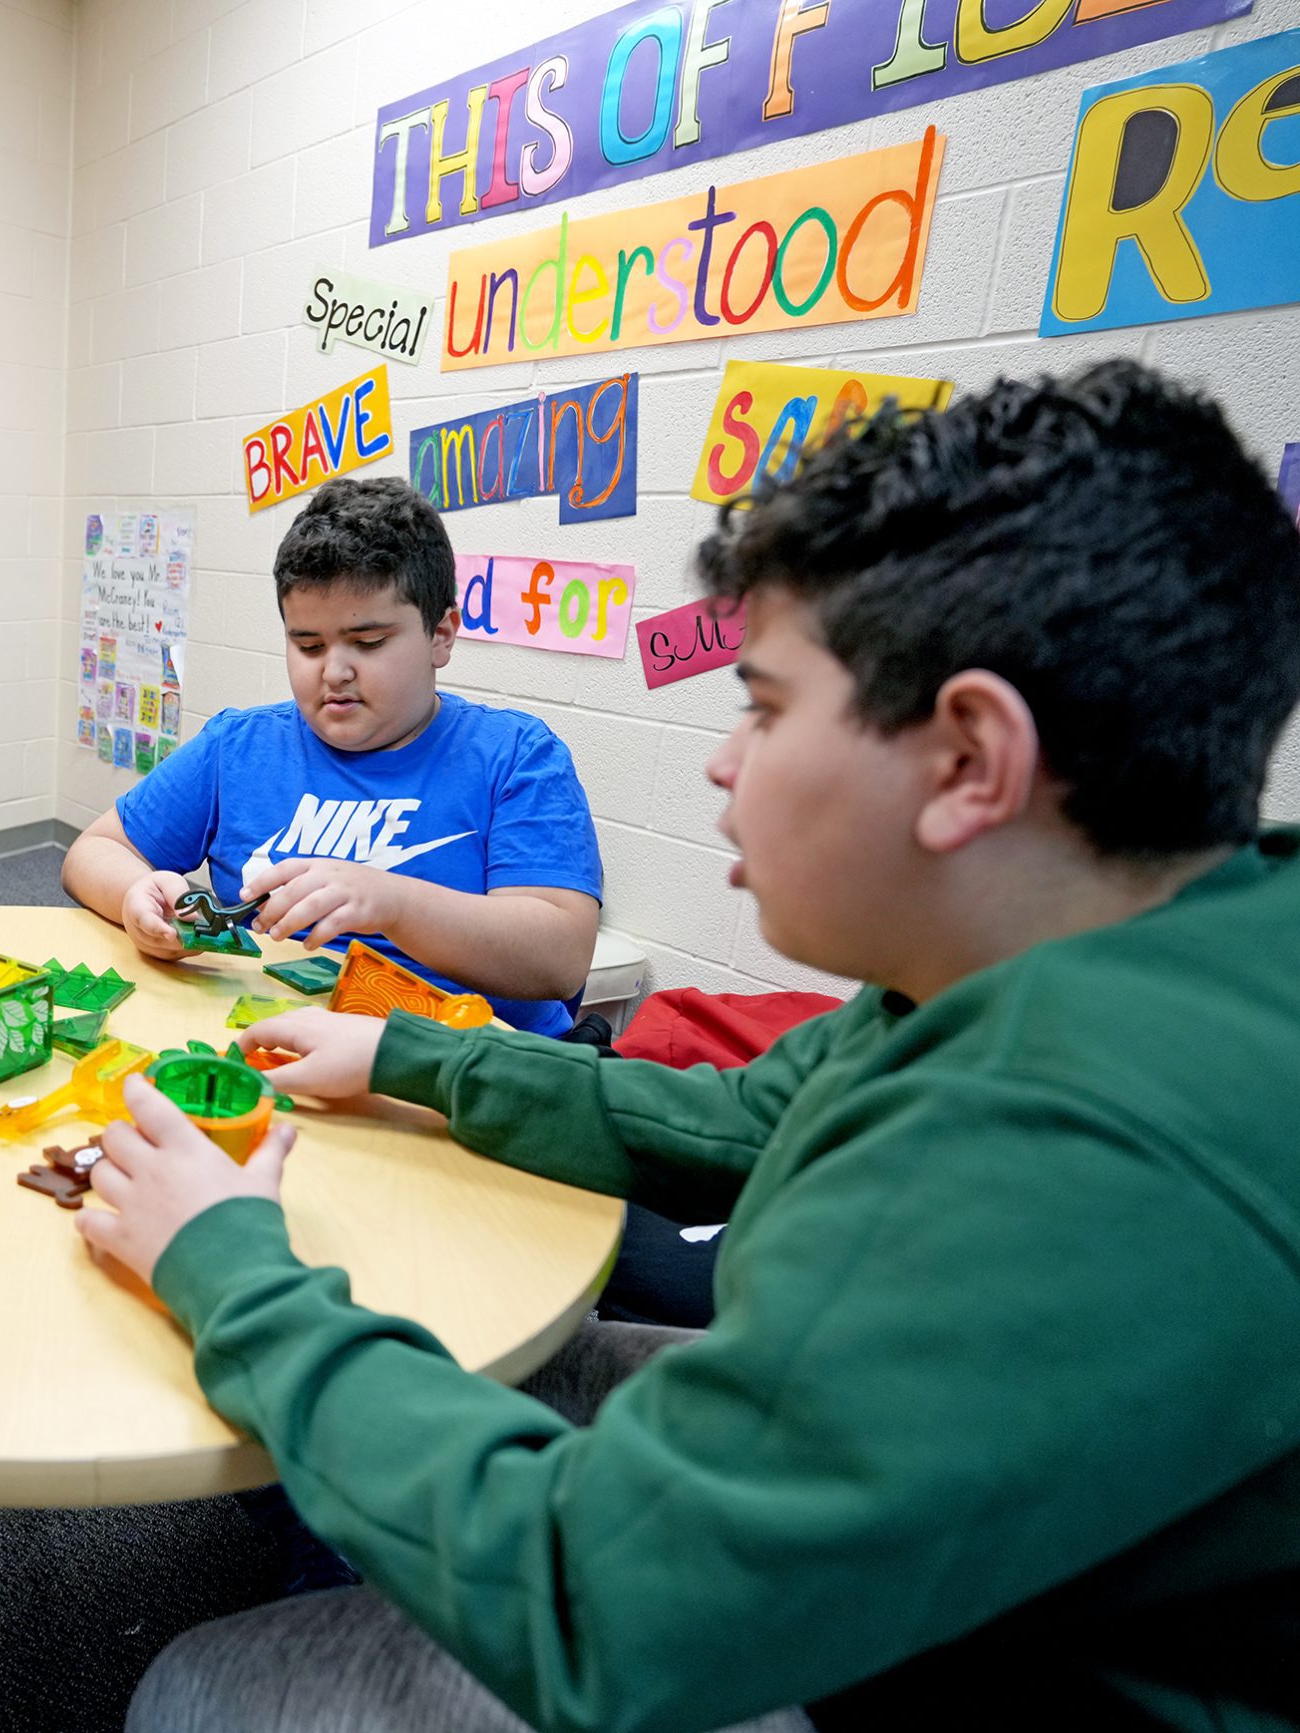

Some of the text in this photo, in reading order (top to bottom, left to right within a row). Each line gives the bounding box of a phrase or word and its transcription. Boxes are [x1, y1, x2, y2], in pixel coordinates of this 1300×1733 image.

[378, 53, 573, 237] THIS
[448, 124, 937, 358] understood
[306, 277, 427, 357] Special
[243, 378, 391, 504] BRAVE
[414, 372, 631, 509] amazing
[93, 560, 144, 589] We love you
[521, 561, 629, 642] for
[128, 613, 150, 633] best!
[276, 793, 422, 862] NIKE
